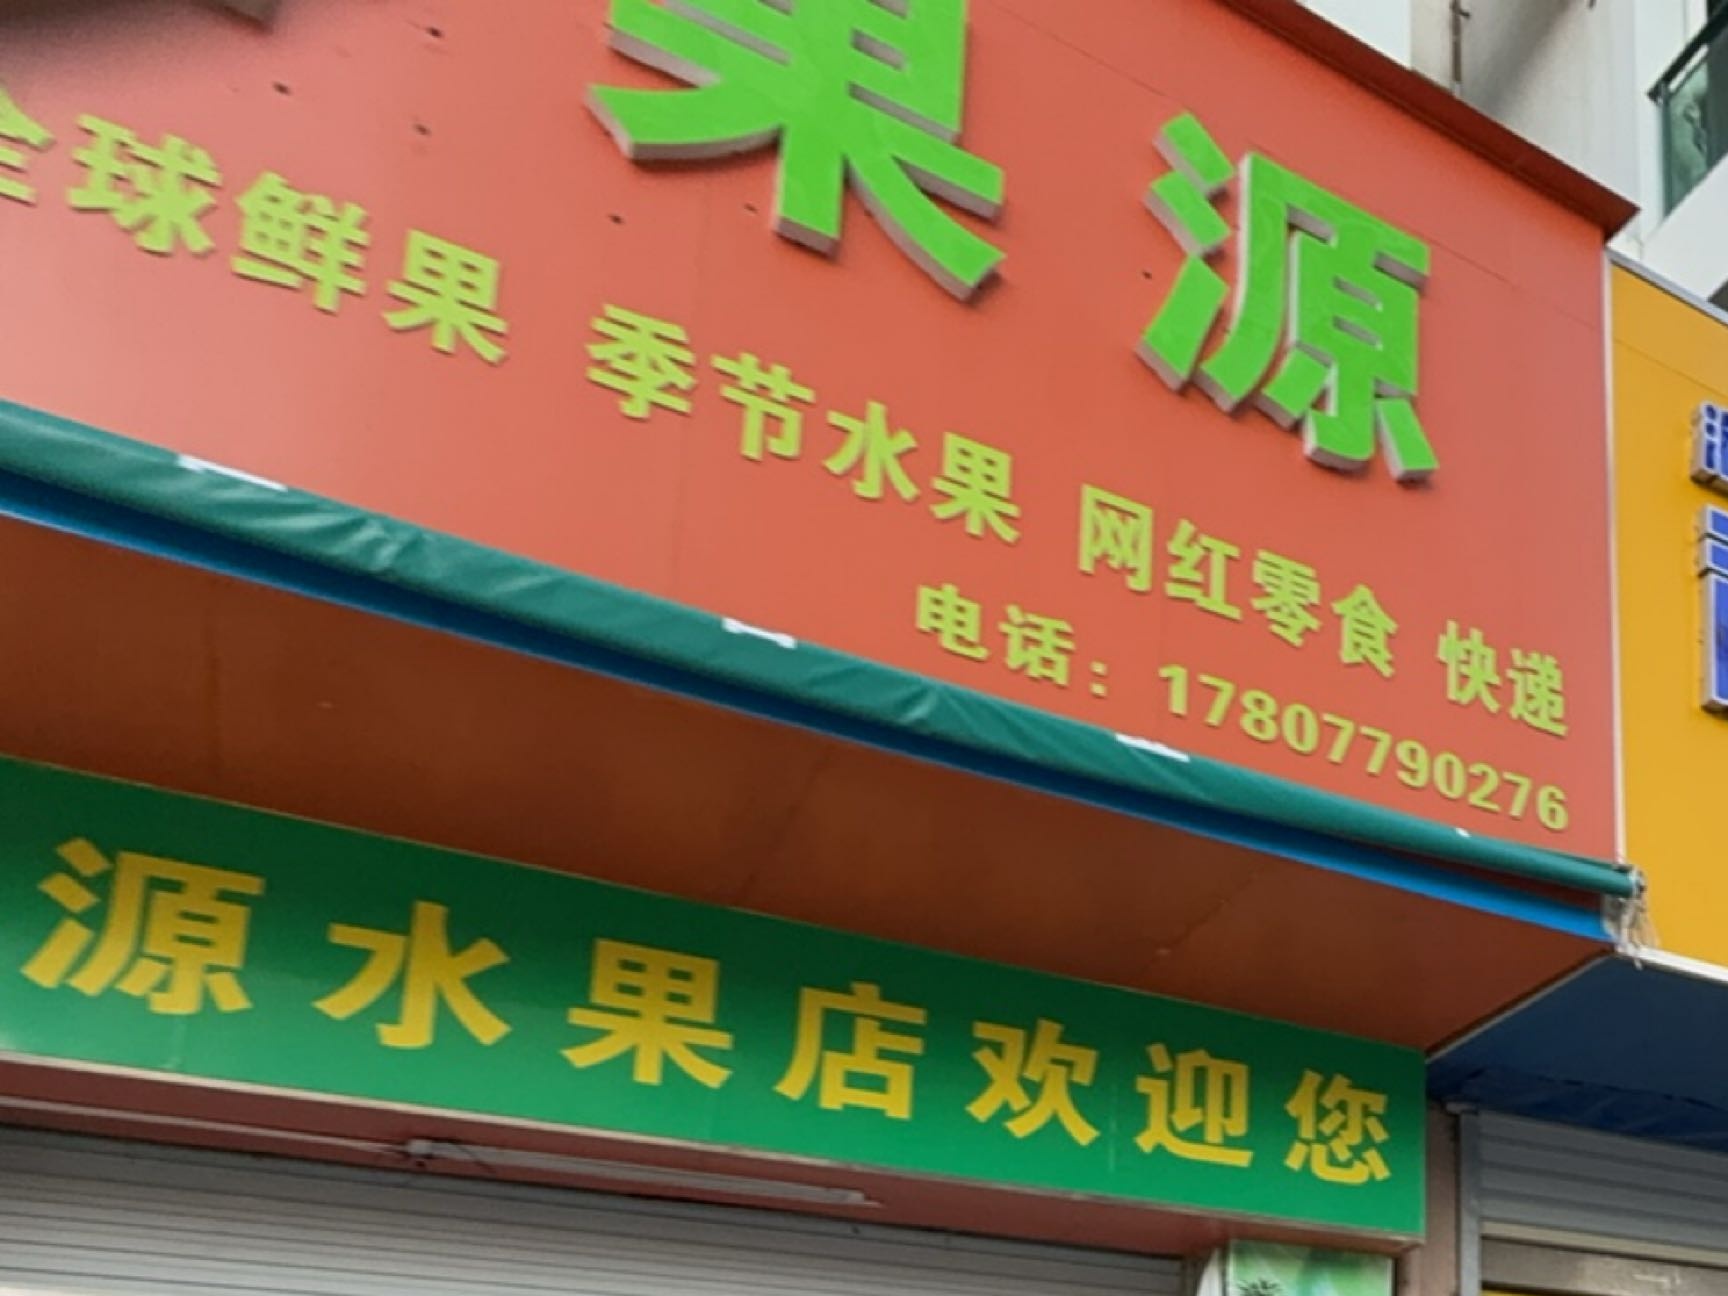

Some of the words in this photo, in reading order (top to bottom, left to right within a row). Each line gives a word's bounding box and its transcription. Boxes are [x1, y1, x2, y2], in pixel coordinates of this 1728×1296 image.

[585, 303, 1022, 545] 季节水果
[1078, 483, 1400, 680] 网红零食
[1436, 620, 1570, 738] 快递
[20, 838, 1393, 1186] 源水果店欢迎您
